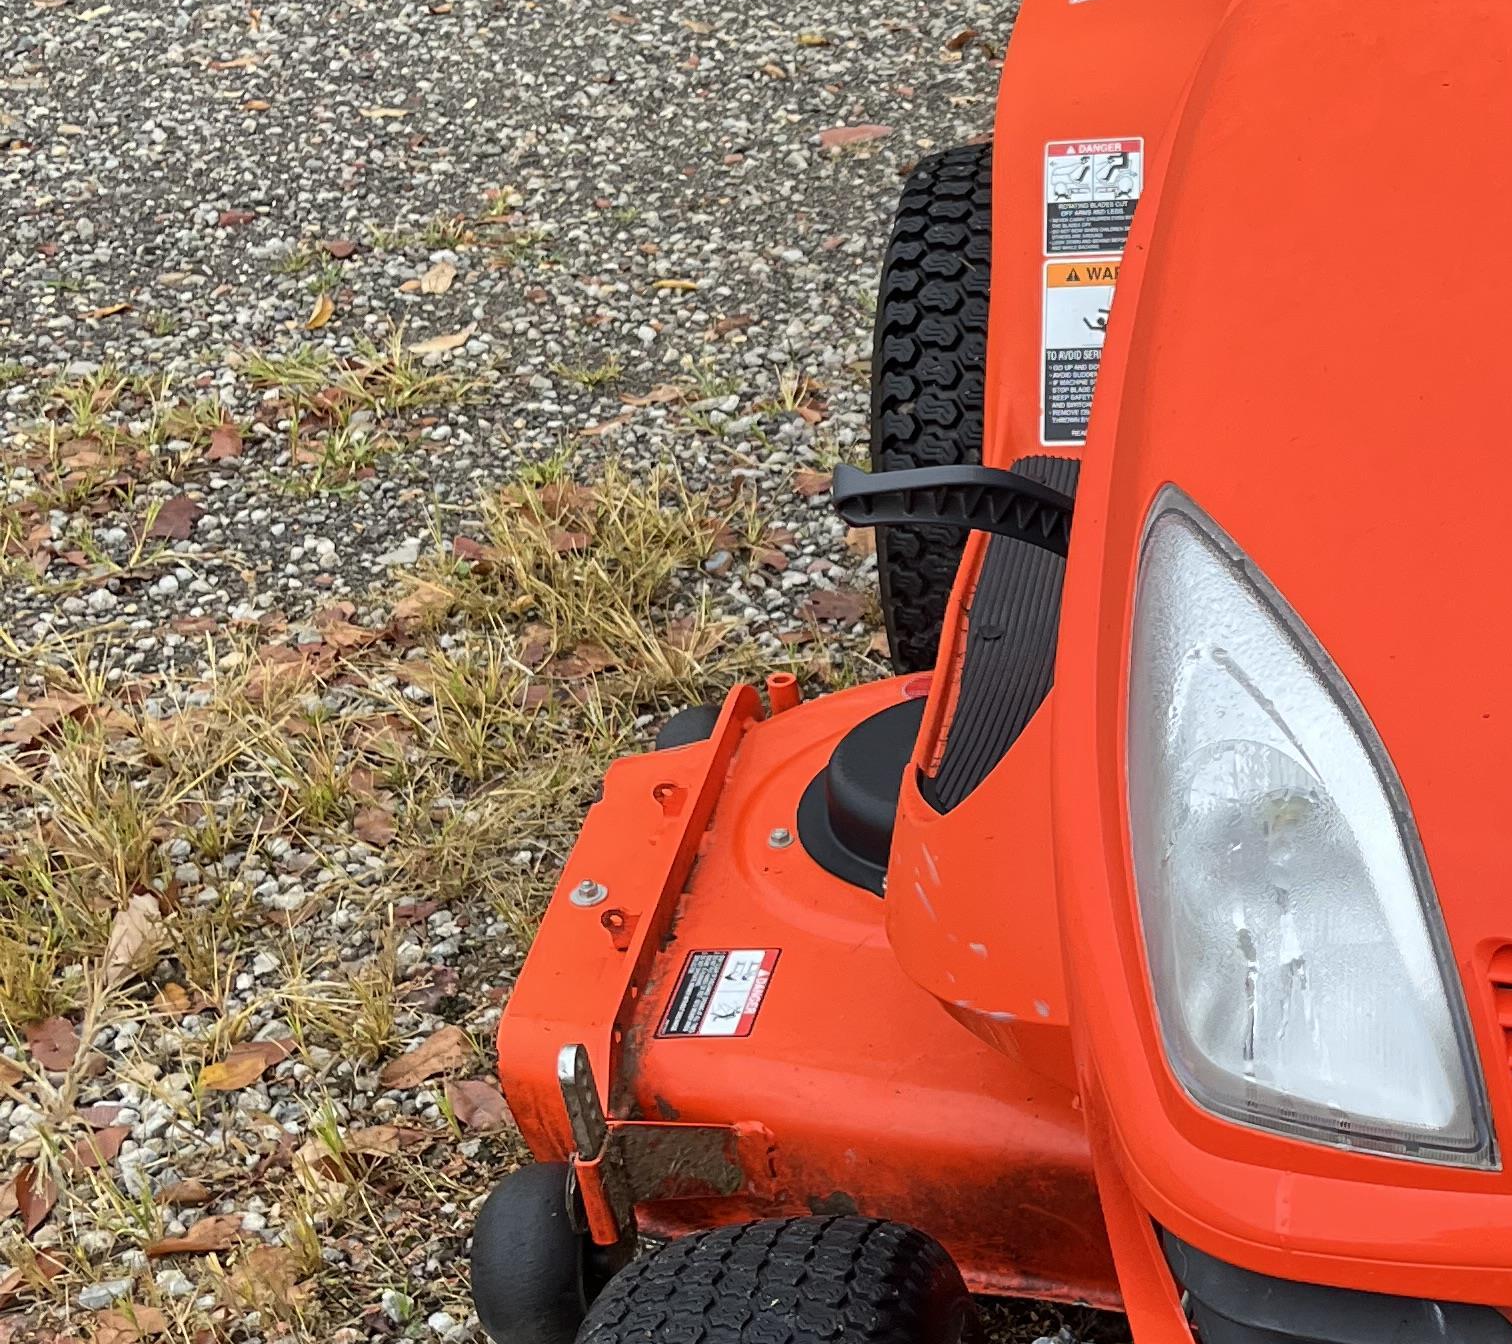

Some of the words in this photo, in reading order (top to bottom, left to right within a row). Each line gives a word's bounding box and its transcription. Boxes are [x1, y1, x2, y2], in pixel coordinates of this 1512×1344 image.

[1078, 142, 1122, 154] DANGER
[1047, 351, 1057, 360] TO
[1059, 350, 1082, 360] AVOID
[743, 977, 769, 1014] DANGER
